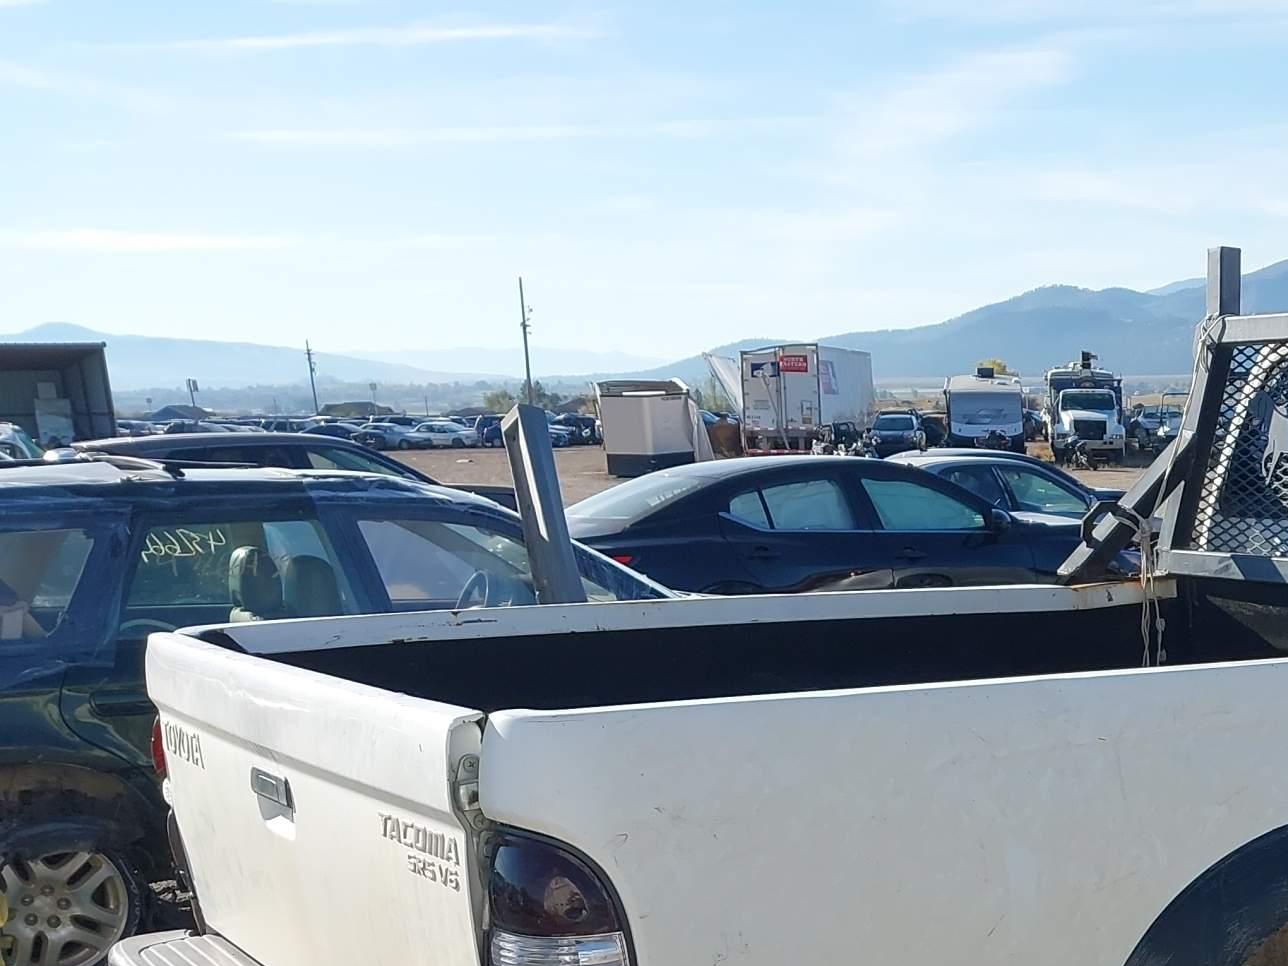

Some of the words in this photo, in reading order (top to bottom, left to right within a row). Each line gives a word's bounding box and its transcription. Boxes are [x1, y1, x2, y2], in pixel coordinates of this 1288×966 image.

[164, 720, 206, 770] TOYOTA
[378, 811, 461, 867] TACOMA
[438, 864, 461, 892] V6
